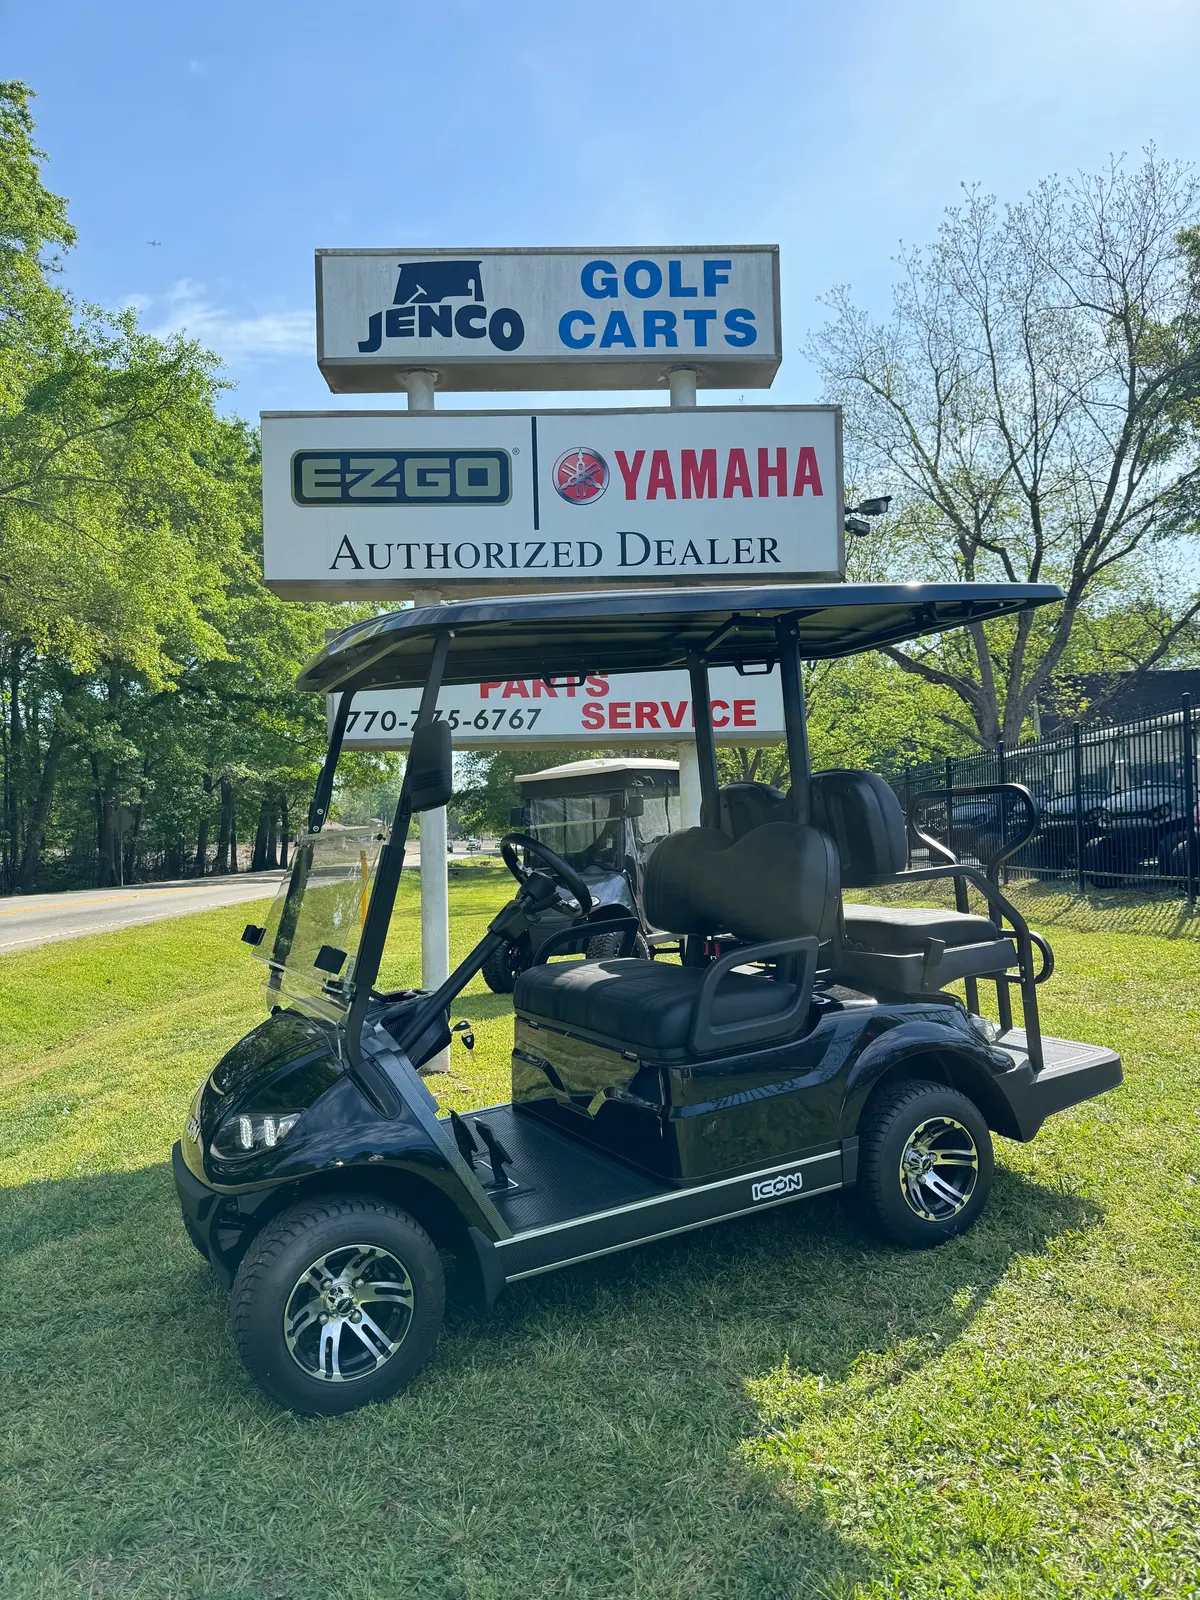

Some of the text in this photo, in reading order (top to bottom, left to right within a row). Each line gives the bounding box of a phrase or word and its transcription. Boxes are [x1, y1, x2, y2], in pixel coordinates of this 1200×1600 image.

[580, 259, 732, 299] GOLF
[357, 303, 525, 353] JENCO
[558, 307, 758, 349] CARTS
[614, 446, 824, 501] YAMAHA
[752, 1172, 803, 1201] ICON
